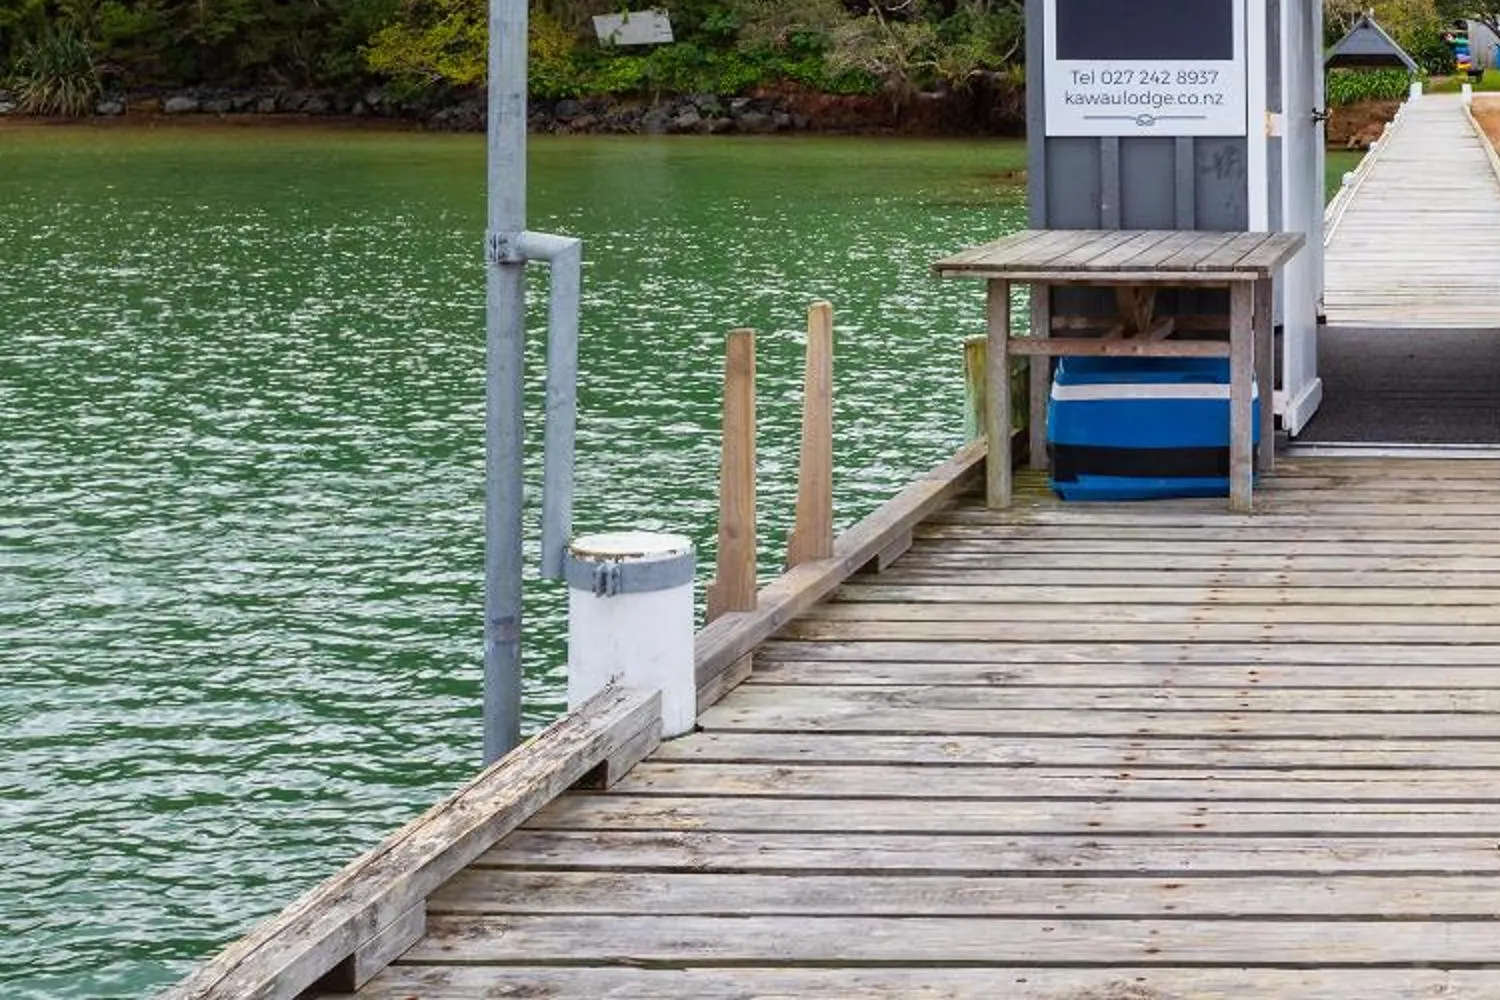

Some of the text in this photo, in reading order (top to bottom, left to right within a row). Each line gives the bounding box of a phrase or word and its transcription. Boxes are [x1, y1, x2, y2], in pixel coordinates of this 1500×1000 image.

[1071, 70, 1219, 86] Tel 027 242 8937
[1065, 90, 1224, 109] kawaulodge.co.nz
